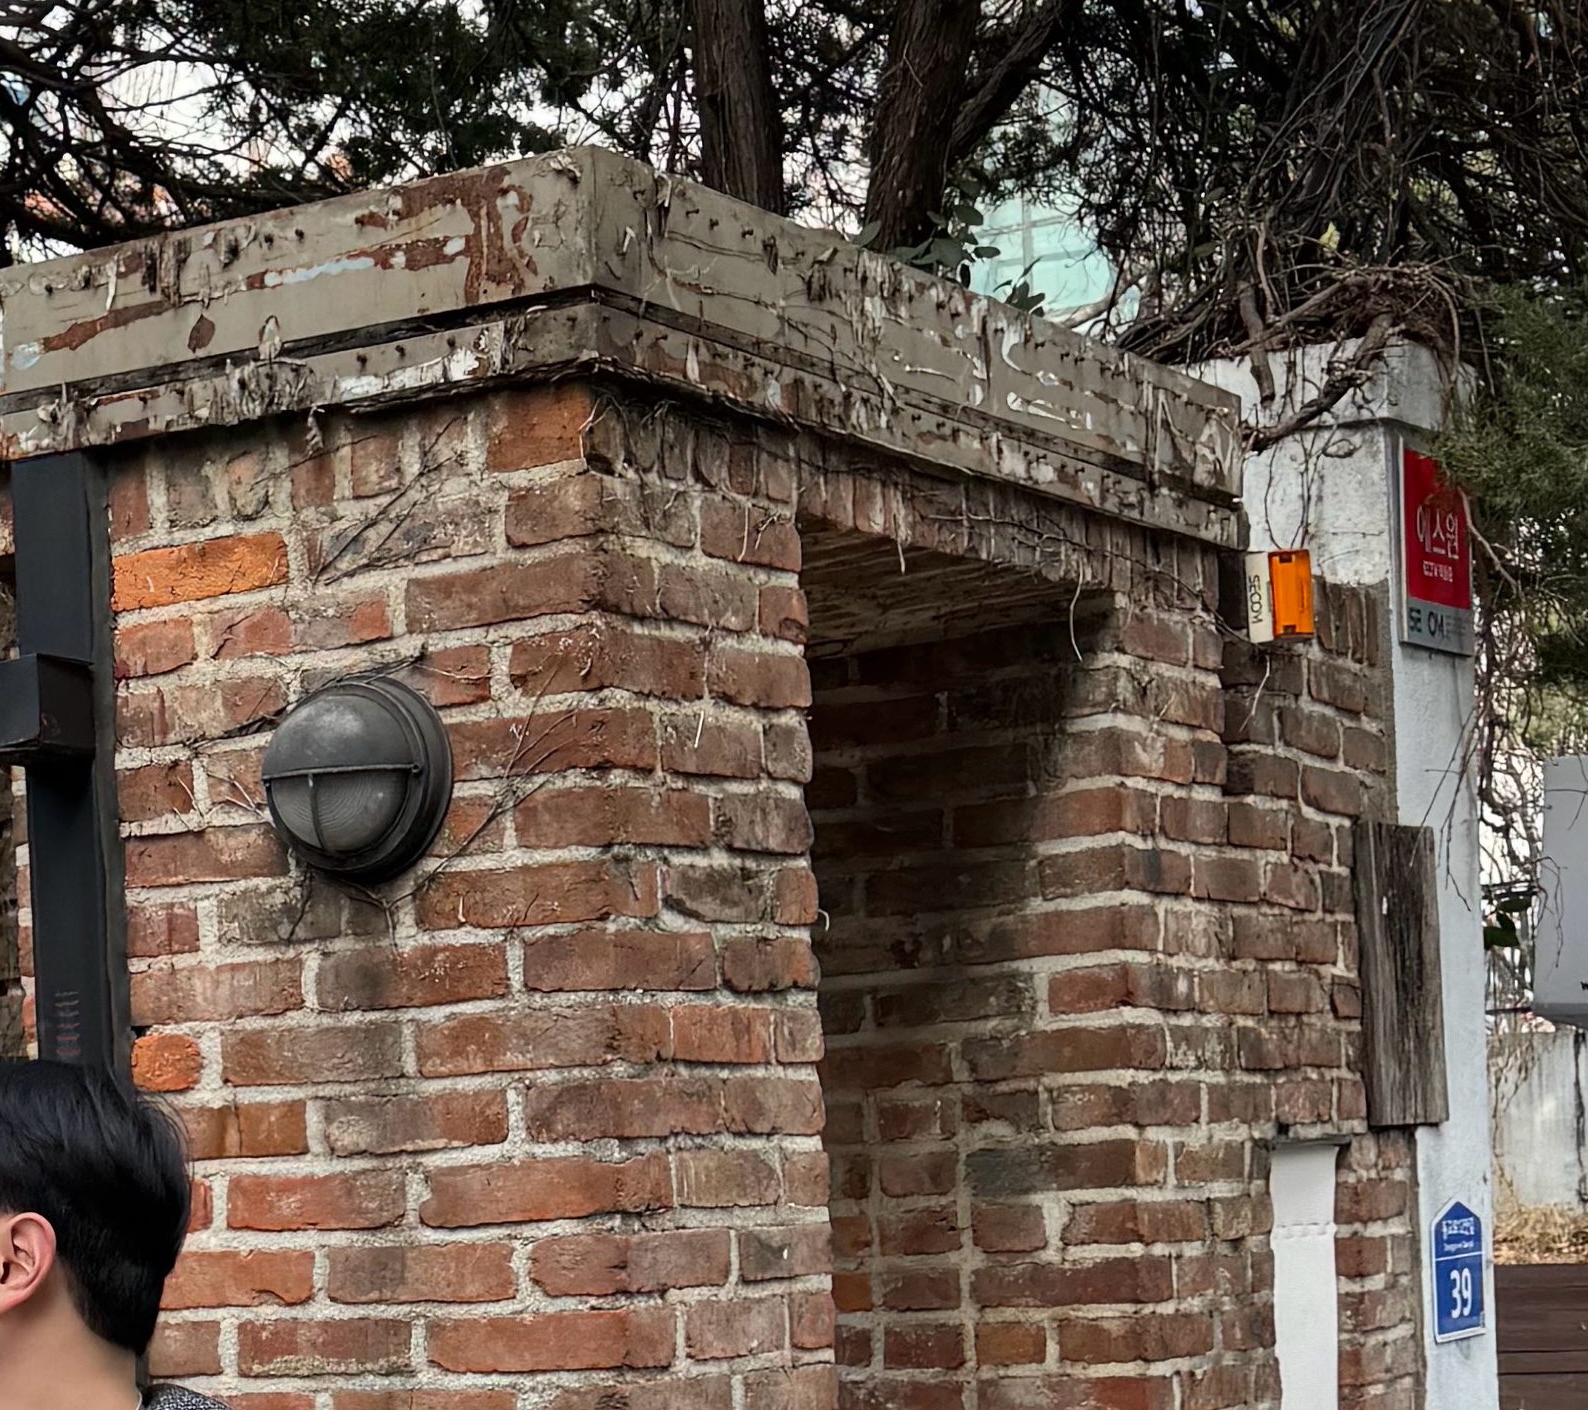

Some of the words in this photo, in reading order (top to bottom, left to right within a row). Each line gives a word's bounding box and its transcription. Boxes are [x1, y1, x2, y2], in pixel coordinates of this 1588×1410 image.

[1416, 504, 1460, 560] 에스원
[1248, 574, 1264, 624] SECOM
[1449, 1267, 1472, 1319] 39
